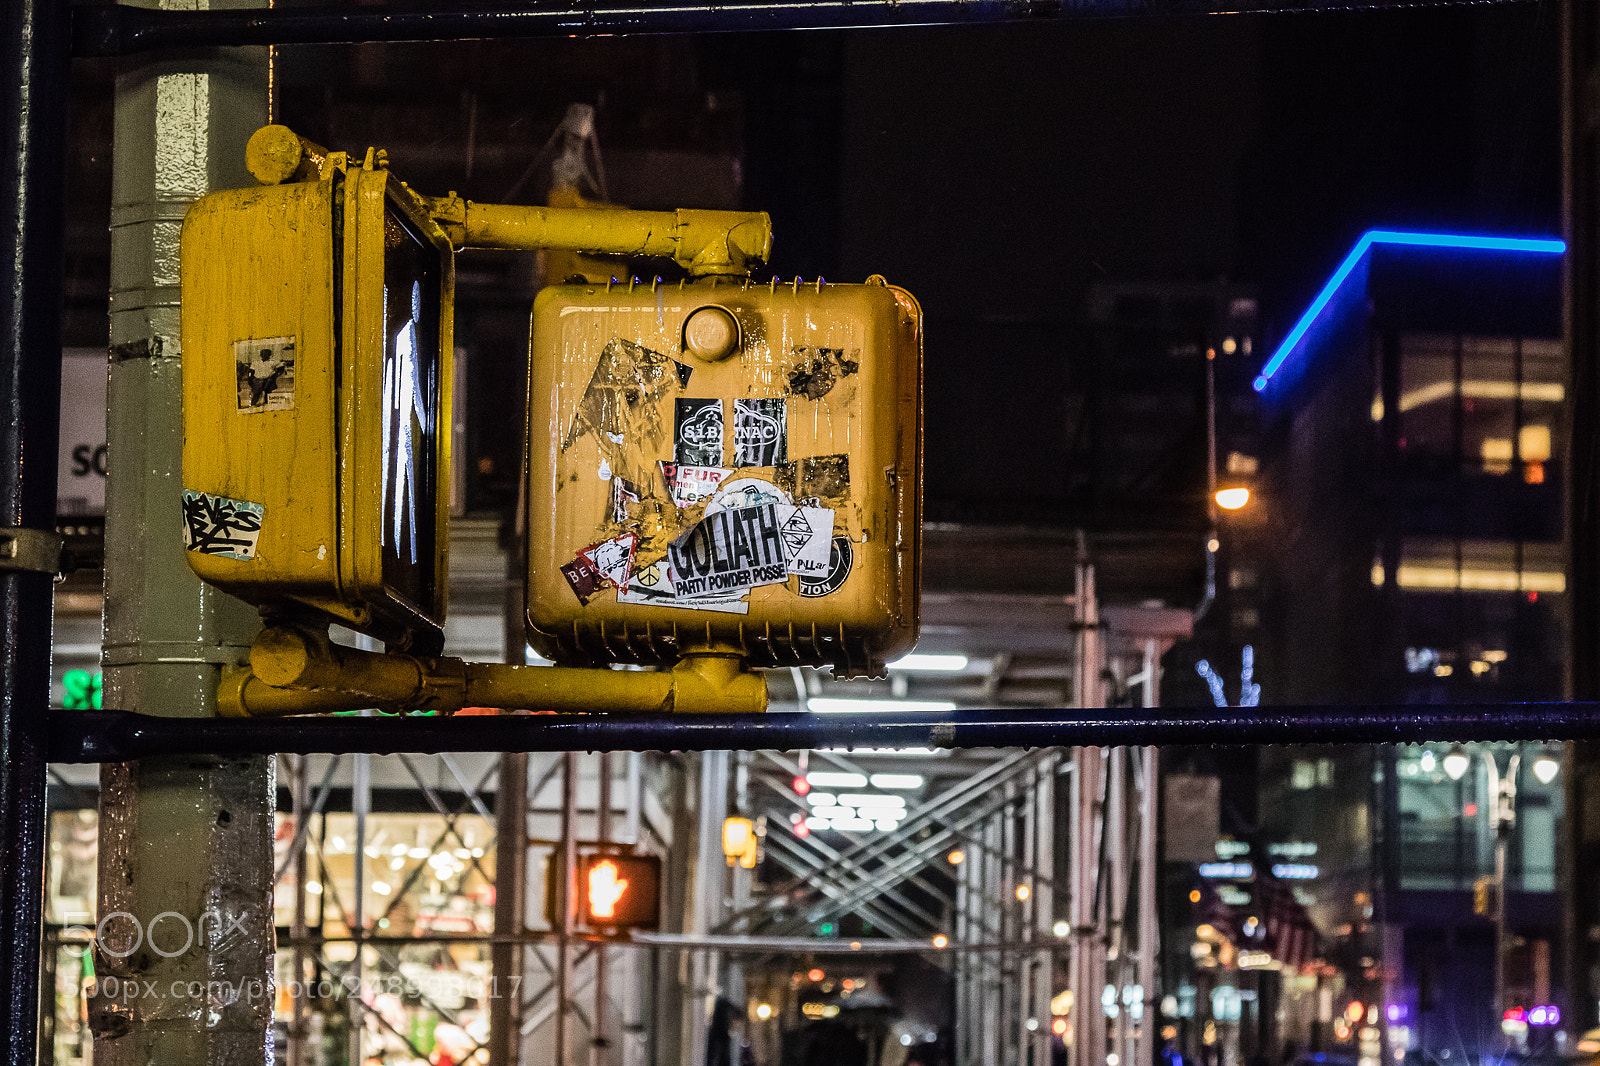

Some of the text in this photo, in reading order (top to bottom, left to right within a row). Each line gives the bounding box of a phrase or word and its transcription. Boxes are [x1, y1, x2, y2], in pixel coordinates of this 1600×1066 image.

[682, 467, 722, 483] FUR
[670, 503, 785, 580] GOLIATH
[675, 564, 787, 596] PARTY POWDER POSSE
